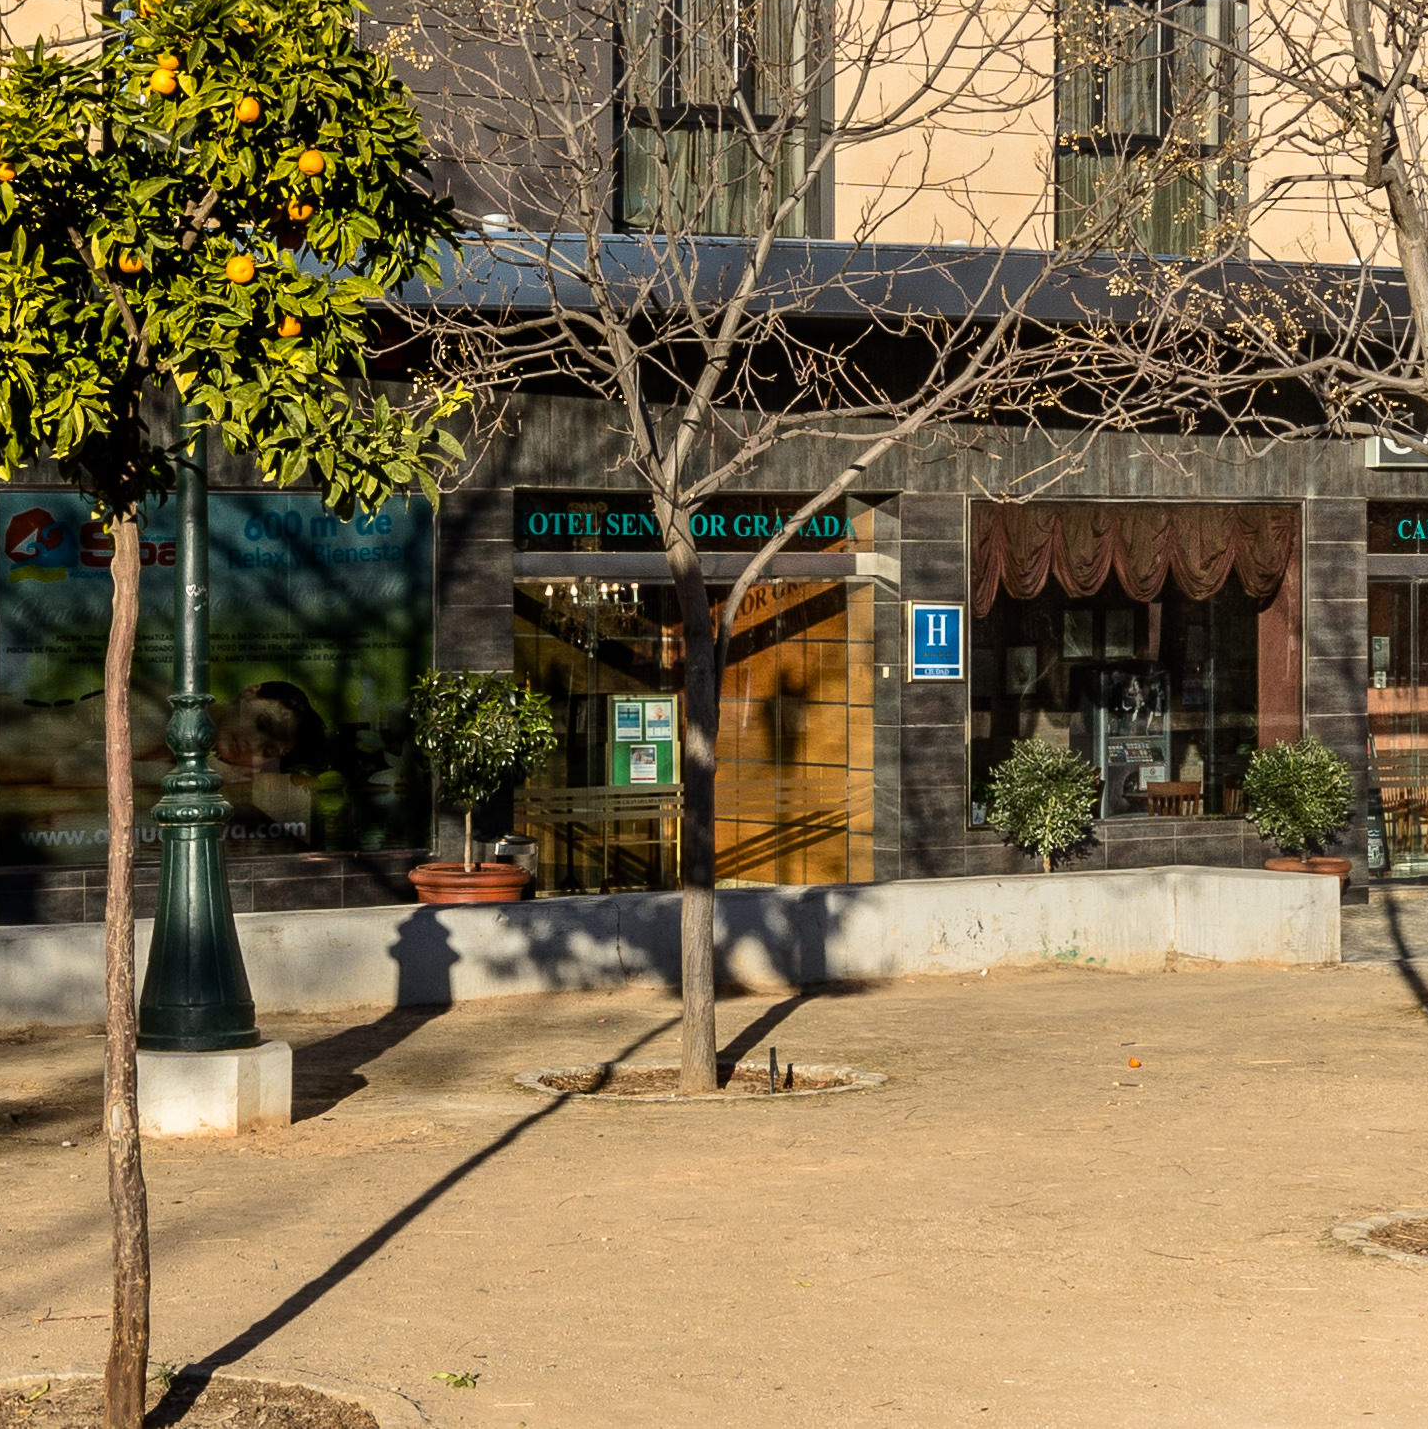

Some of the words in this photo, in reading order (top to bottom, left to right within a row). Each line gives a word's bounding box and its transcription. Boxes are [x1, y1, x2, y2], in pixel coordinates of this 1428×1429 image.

[243, 510, 303, 541] 600
[356, 507, 393, 536] de
[606, 512, 728, 537] SENOR
[732, 513, 857, 538] GRAADA
[227, 547, 288, 569] Relax
[291, 551, 304, 570] y
[312, 541, 415, 565] Bienestar
[926, 614, 948, 646] H
[924, 668, 950, 676] CIUDAD
